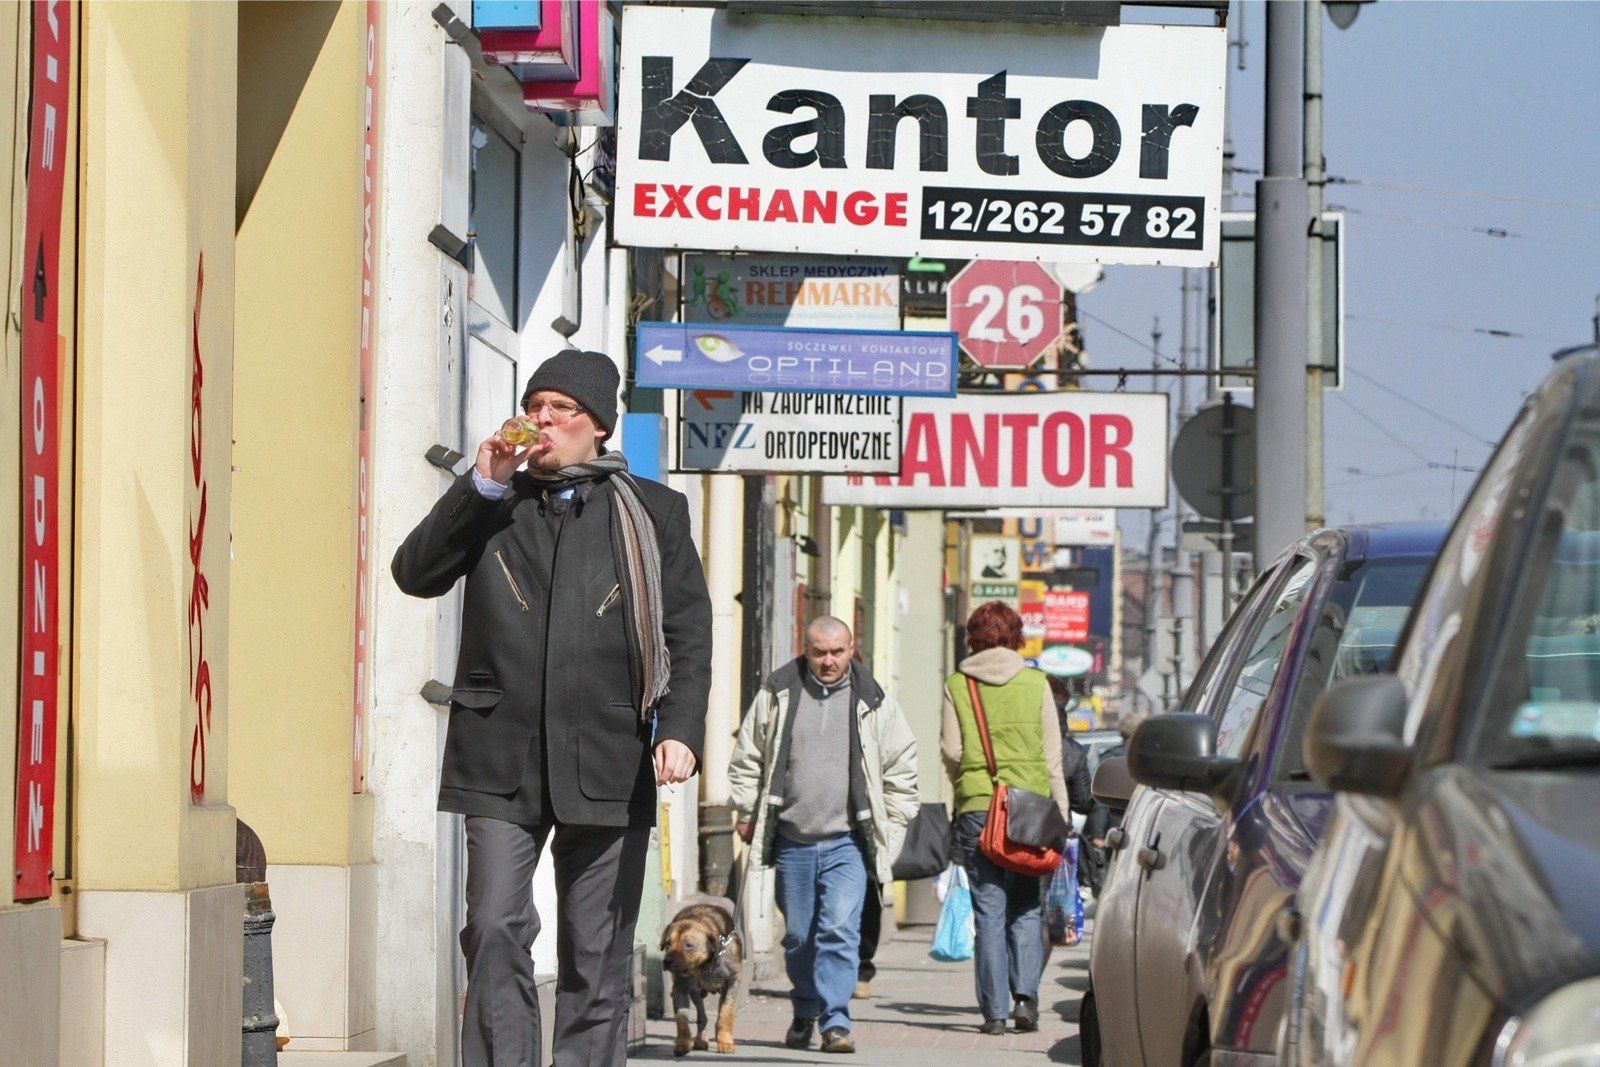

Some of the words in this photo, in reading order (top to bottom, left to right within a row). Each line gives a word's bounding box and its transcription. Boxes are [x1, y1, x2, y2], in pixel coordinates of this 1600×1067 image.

[638, 55, 1200, 180] Kantor
[361, 24, 375, 351] OBUWIE
[633, 183, 908, 227] EXCHANGE
[927, 197, 1065, 234] 12/262
[1080, 201, 1131, 238] 57
[1146, 205, 1197, 239] 82
[750, 265, 799, 277] SKLEP
[804, 265, 888, 277] MEDYCZNY
[745, 281, 895, 306] REHMARK
[966, 284, 1045, 345] 26
[787, 341, 852, 353] SOCZEWKI
[862, 344, 947, 356] KONTAKTOWE
[748, 355, 947, 379] OPTILAND
[741, 392, 763, 413] NA
[686, 422, 756, 449] NFZ
[764, 430, 892, 460] ORTOPEDYCZNE
[847, 411, 1134, 489] ANTOR
